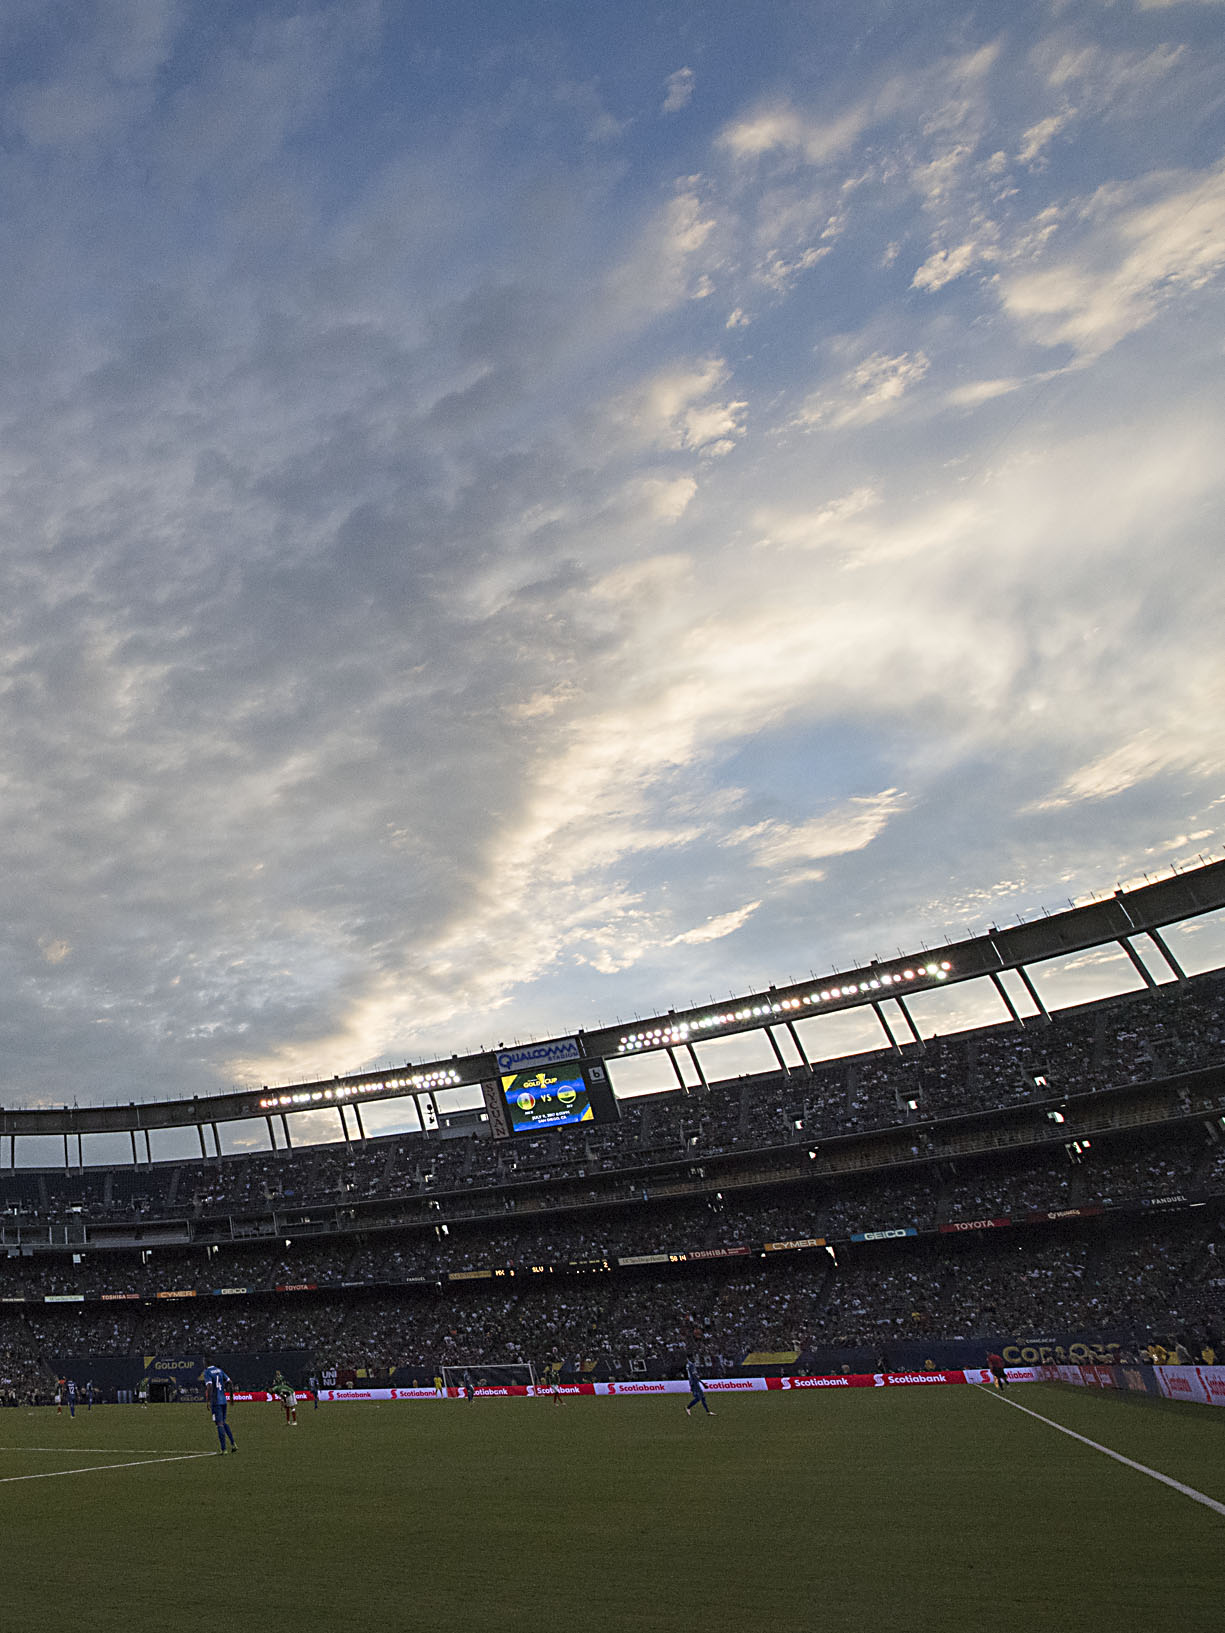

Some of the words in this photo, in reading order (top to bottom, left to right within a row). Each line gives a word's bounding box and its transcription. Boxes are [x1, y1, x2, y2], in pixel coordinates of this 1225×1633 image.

[498, 1043, 577, 1070] QUALCOMM
[548, 1052, 579, 1062] STADIUM
[545, 1077, 558, 1085] CUP
[540, 1093, 552, 1103] VS
[486, 1083, 506, 1136] SYCUAN
[1152, 1195, 1187, 1205] FANDUEL
[954, 1220, 995, 1231] TOYOTA
[864, 1229, 907, 1241] GEICO
[772, 1239, 817, 1250] CYMER
[689, 1249, 727, 1258] TOSHIBA
[155, 1361, 177, 1370] GOLD
[178, 1360, 195, 1369] CUP
[216, 1375, 222, 1391] 4
[794, 1378, 849, 1387] Scotiabank
[888, 1374, 947, 1384] Scotiabank
[537, 1386, 580, 1394] Scotbank
[619, 1384, 665, 1392] Scotiabank
